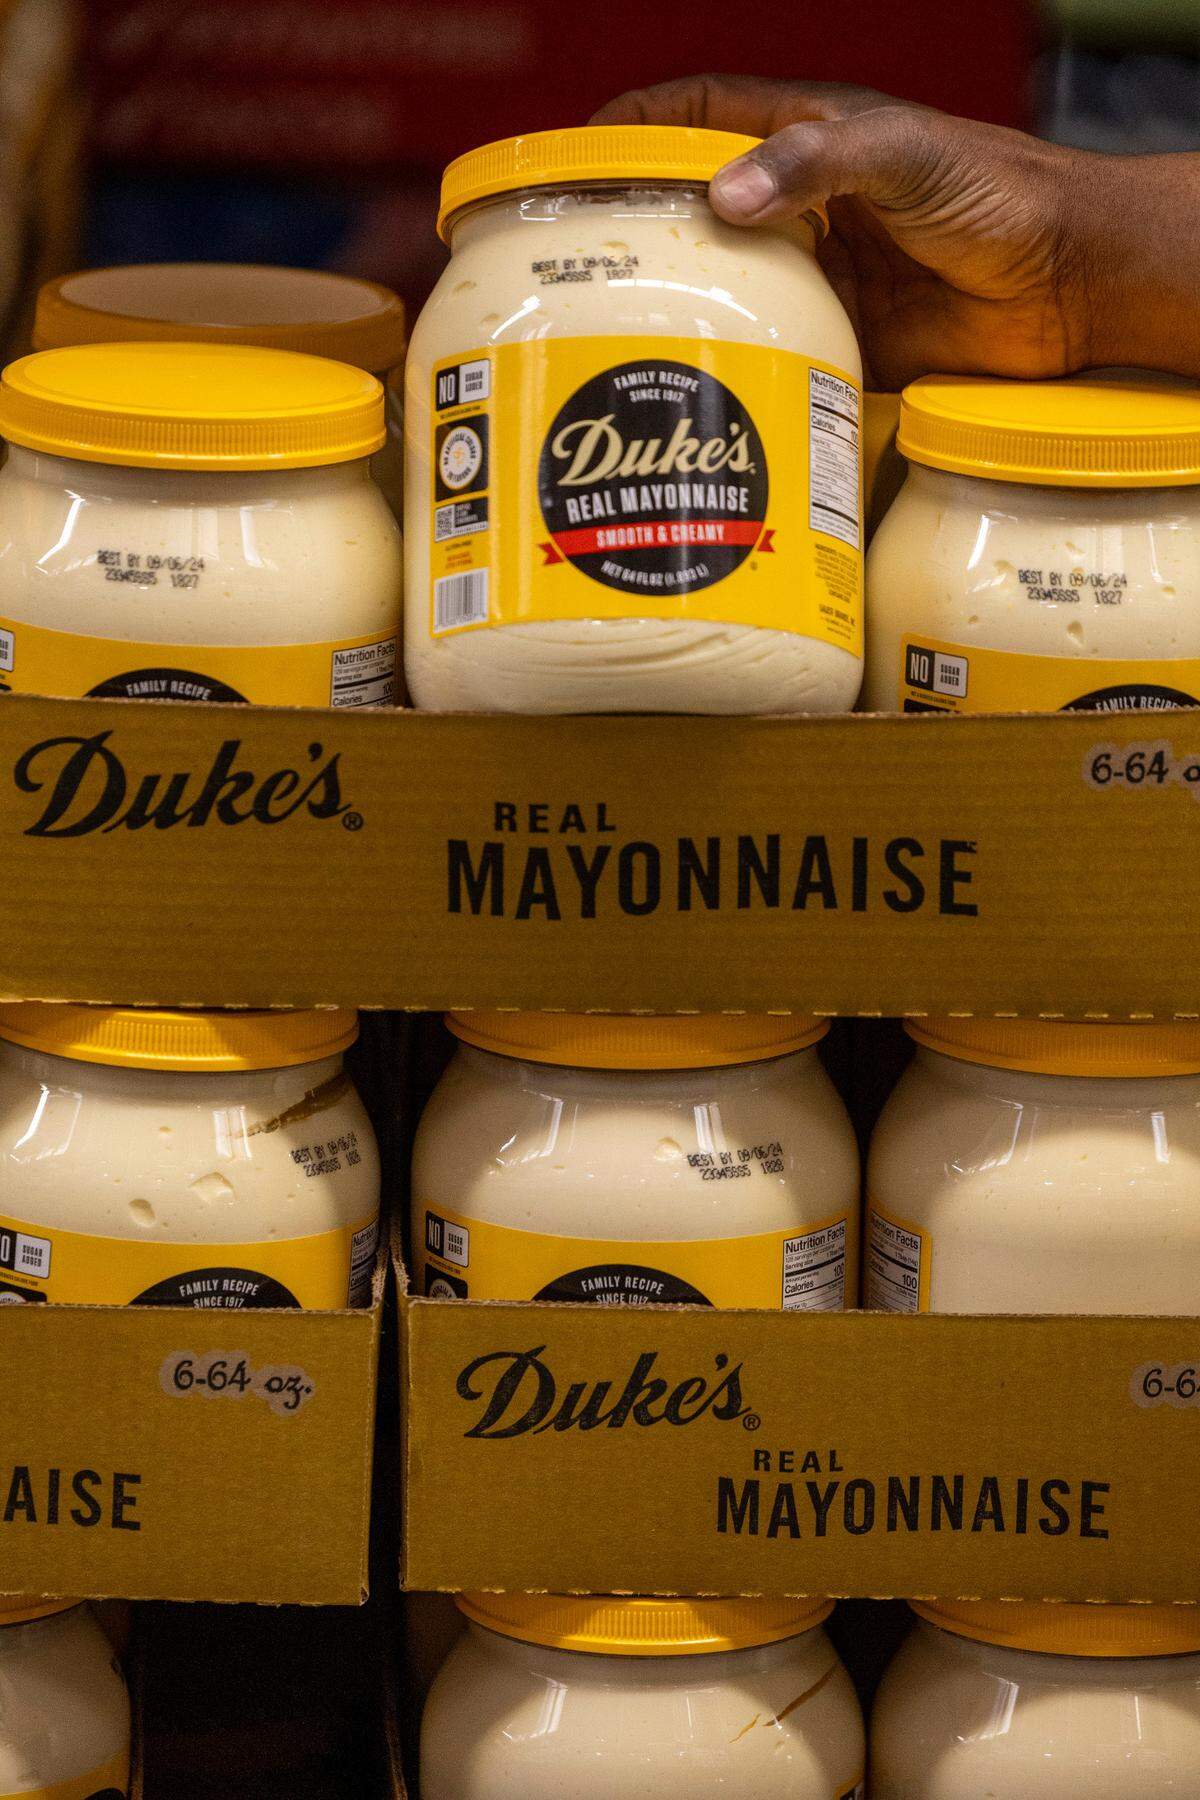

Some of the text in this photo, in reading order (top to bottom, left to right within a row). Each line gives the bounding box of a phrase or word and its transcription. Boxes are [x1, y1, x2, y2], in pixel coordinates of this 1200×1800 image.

[532, 260, 557, 273] BEST
[563, 258, 576, 270] BY
[439, 373, 456, 404] NO
[613, 371, 699, 392] FAMILY RECIPE
[811, 371, 844, 394] Nutrition
[629, 388, 660, 403] SINCE
[812, 415, 836, 432] Calories
[552, 413, 756, 486] Duke's
[565, 483, 749, 524] REAL MAYONNAISE
[596, 524, 725, 548] SMOOTH & CREAMY
[98, 550, 121, 567] BEST
[127, 553, 140, 568] BY
[170, 573, 199, 588] 1827
[1018, 569, 1128, 588] BEST BY 09/06/24
[1094, 591, 1122, 605] 1827
[334, 643, 395, 665] Nutrition Facts
[911, 652, 929, 683] NO
[126, 680, 212, 701] FAMILY RECIPE
[333, 695, 362, 706] Calories
[1095, 695, 1136, 712] FAMILY
[1091, 750, 1169, 784] 6-64
[14, 730, 351, 838] Duke's
[494, 802, 616, 833] REAL
[447, 834, 978, 920] MAYONNAISE
[686, 1142, 784, 1167] BEST BY 09/06/24
[429, 1219, 441, 1250] NO
[785, 1235, 825, 1254] Nutrition
[827, 1226, 844, 1241] Facts
[896, 1230, 919, 1250] Facts
[0, 1234, 10, 1262] O
[22, 1244, 43, 1257] SUGAR
[785, 1262, 803, 1270] Serving
[179, 1279, 260, 1297] FAMILY RECIPE
[581, 1276, 665, 1295] FAMILY RECIPE
[785, 1280, 814, 1294] Calories
[834, 1263, 844, 1277] 100
[902, 1274, 917, 1289] 100
[193, 1296, 245, 1309] SINCE 1917
[596, 1293, 649, 1304] SINCE 1917
[173, 1360, 312, 1410] 6-64 oz.
[456, 1345, 751, 1439] Duke's
[1143, 1368, 1200, 1398] 6-6
[753, 1449, 844, 1473] REAL
[717, 1475, 1110, 1539] MAYONNAISE
